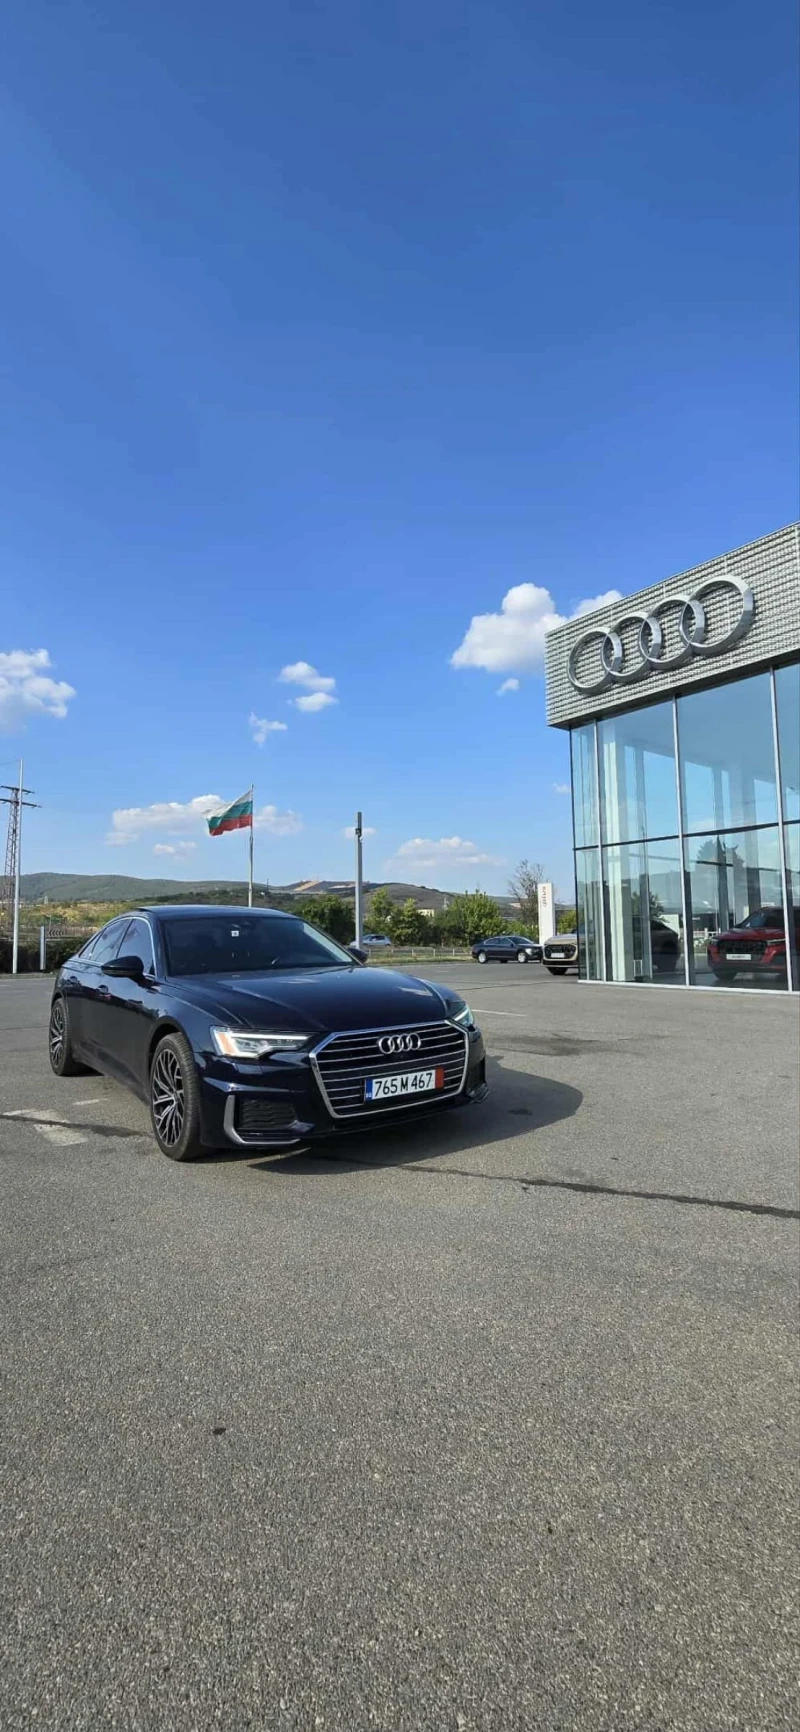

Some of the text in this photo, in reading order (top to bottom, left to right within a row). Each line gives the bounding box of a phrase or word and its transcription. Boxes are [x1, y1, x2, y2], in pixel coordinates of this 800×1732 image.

[374, 1072, 433, 1097] 765 M 467
